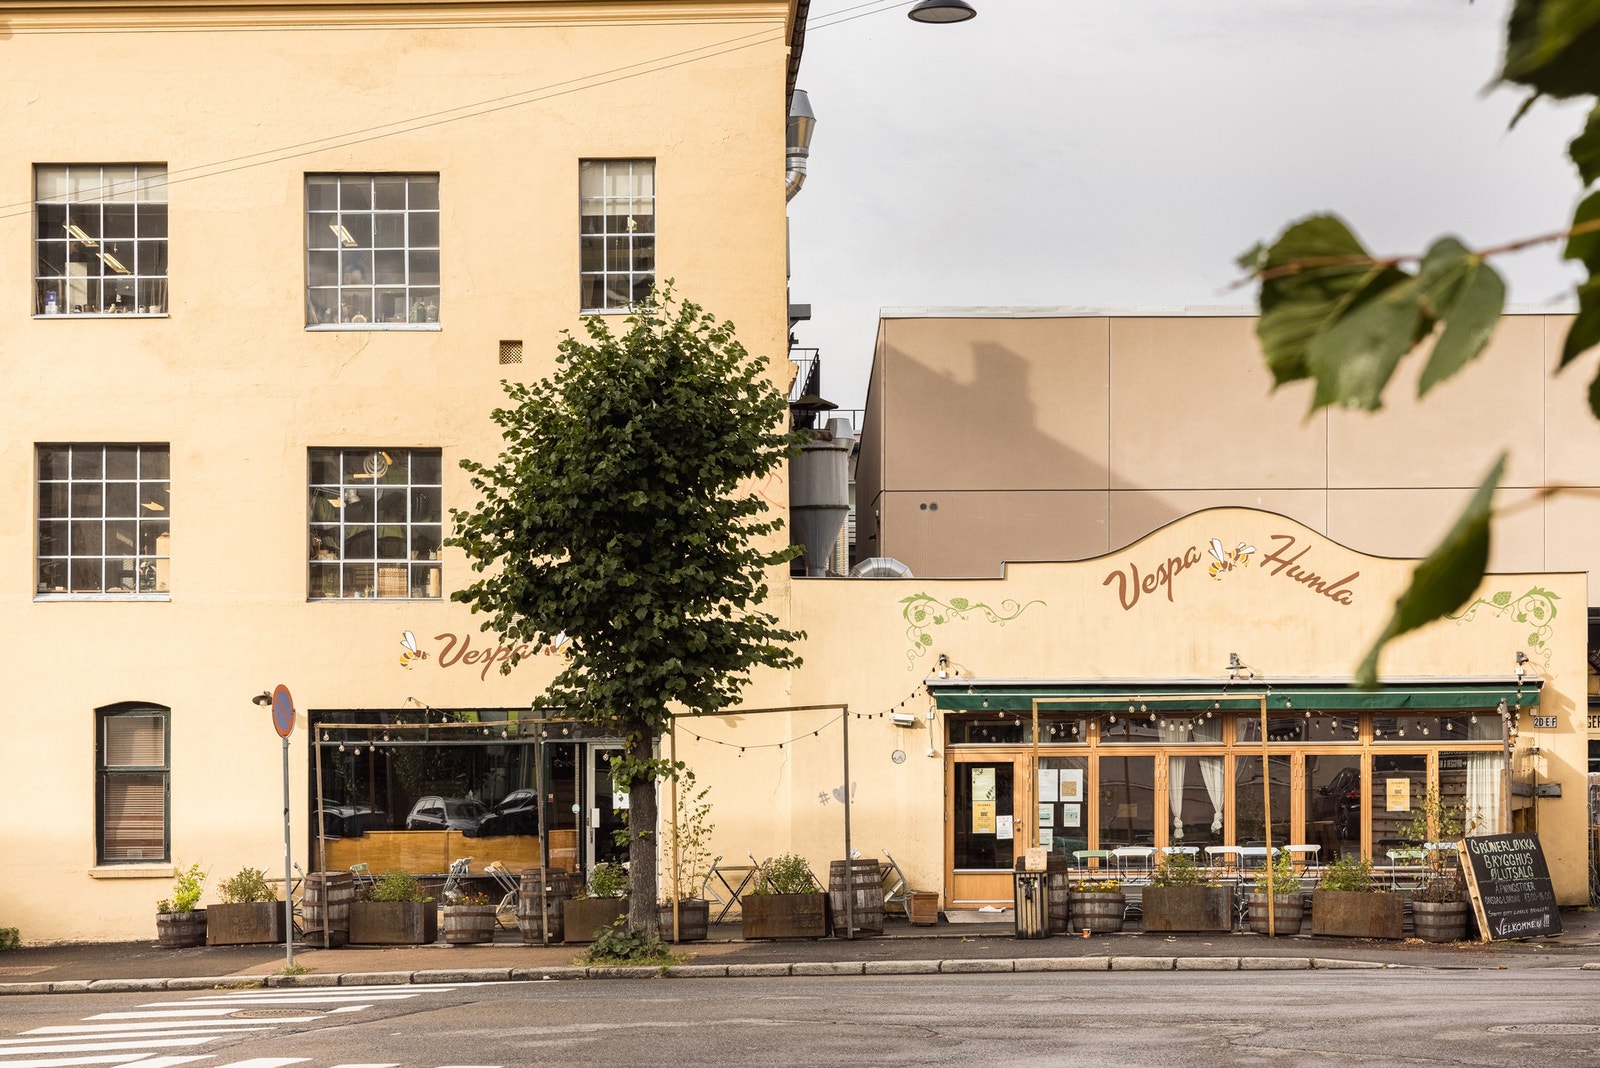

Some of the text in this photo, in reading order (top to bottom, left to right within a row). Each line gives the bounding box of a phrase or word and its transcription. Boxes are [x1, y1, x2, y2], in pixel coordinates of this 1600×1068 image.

[1103, 535, 1360, 610] Vespa Humla
[434, 633, 533, 681] Vespa
[1483, 852, 1533, 868] BRYGGHUS
[1490, 865, 1534, 880] ØLUTSALG
